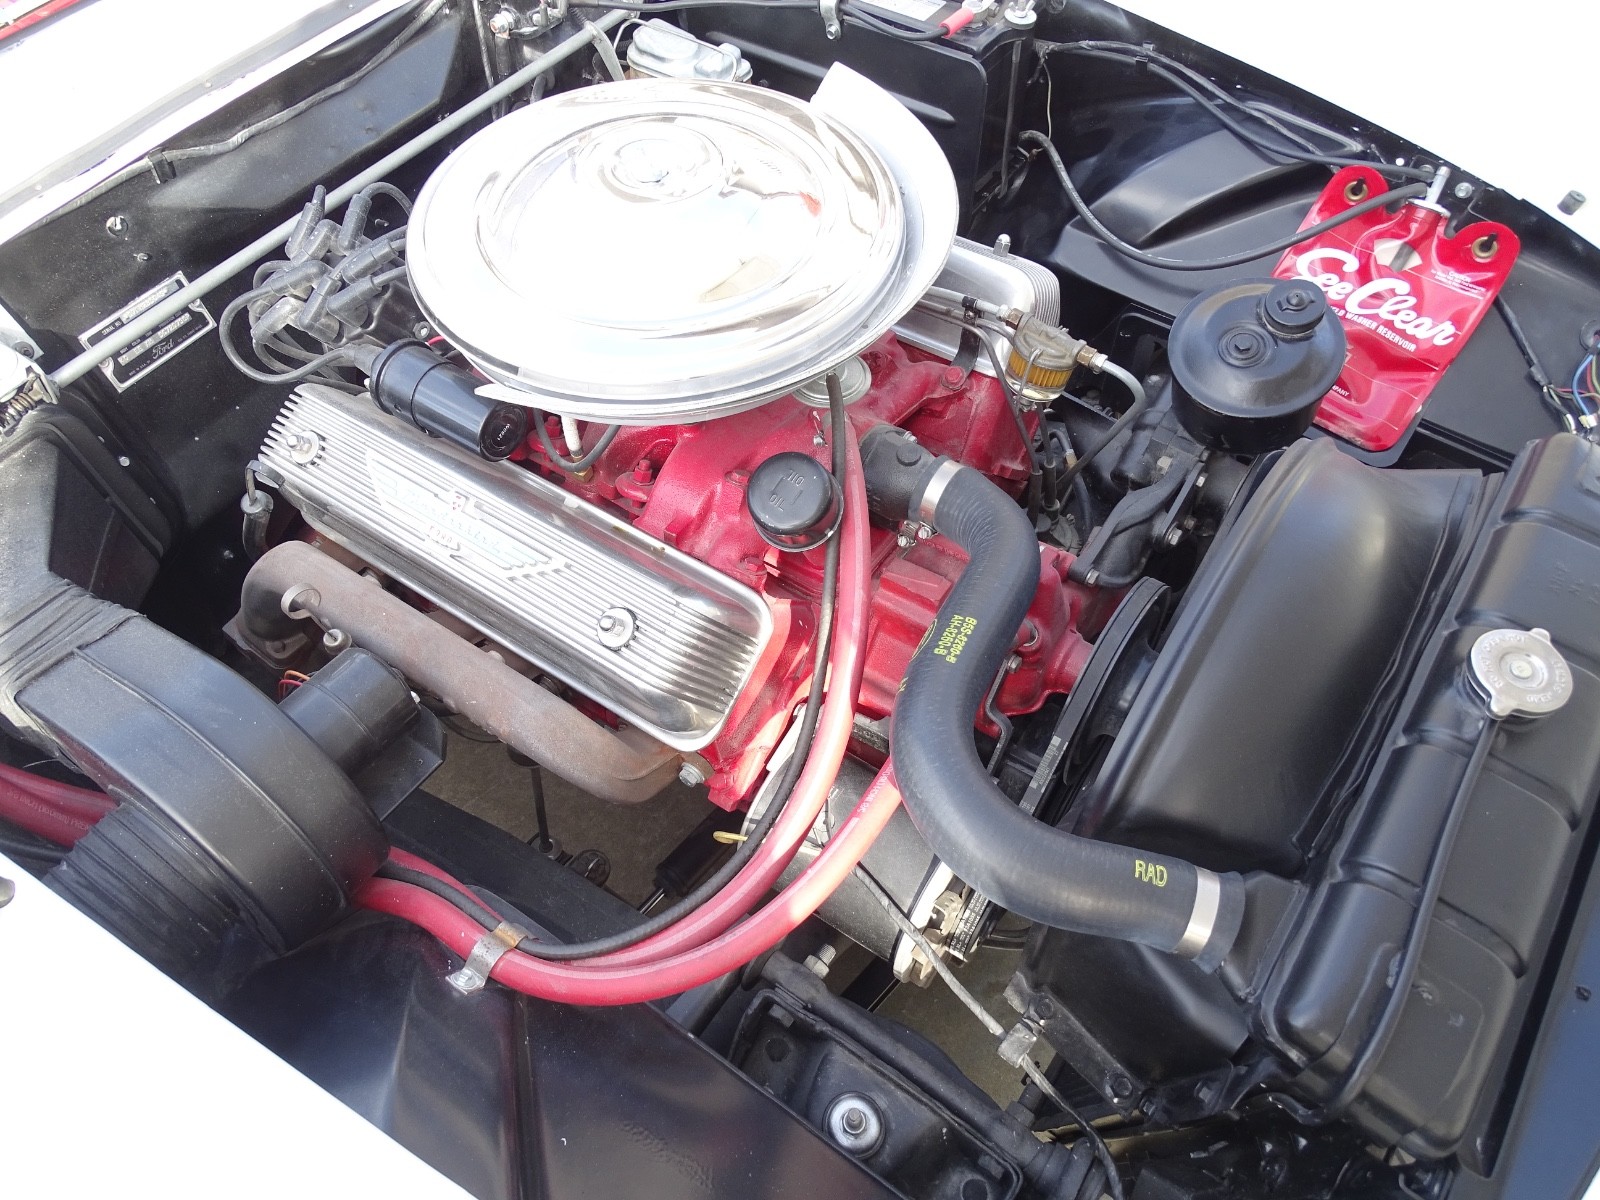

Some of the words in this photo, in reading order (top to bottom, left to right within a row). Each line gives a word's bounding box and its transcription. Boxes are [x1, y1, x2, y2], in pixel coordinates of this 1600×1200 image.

[1291, 247, 1359, 300] See
[1345, 277, 1454, 346] Clear
[152, 338, 174, 359] Ford
[1345, 312, 1377, 331] WASHER
[1377, 325, 1416, 352] RESERVOIR
[934, 614, 964, 656] AH-8260-B
[1134, 860, 1168, 887] RAD
